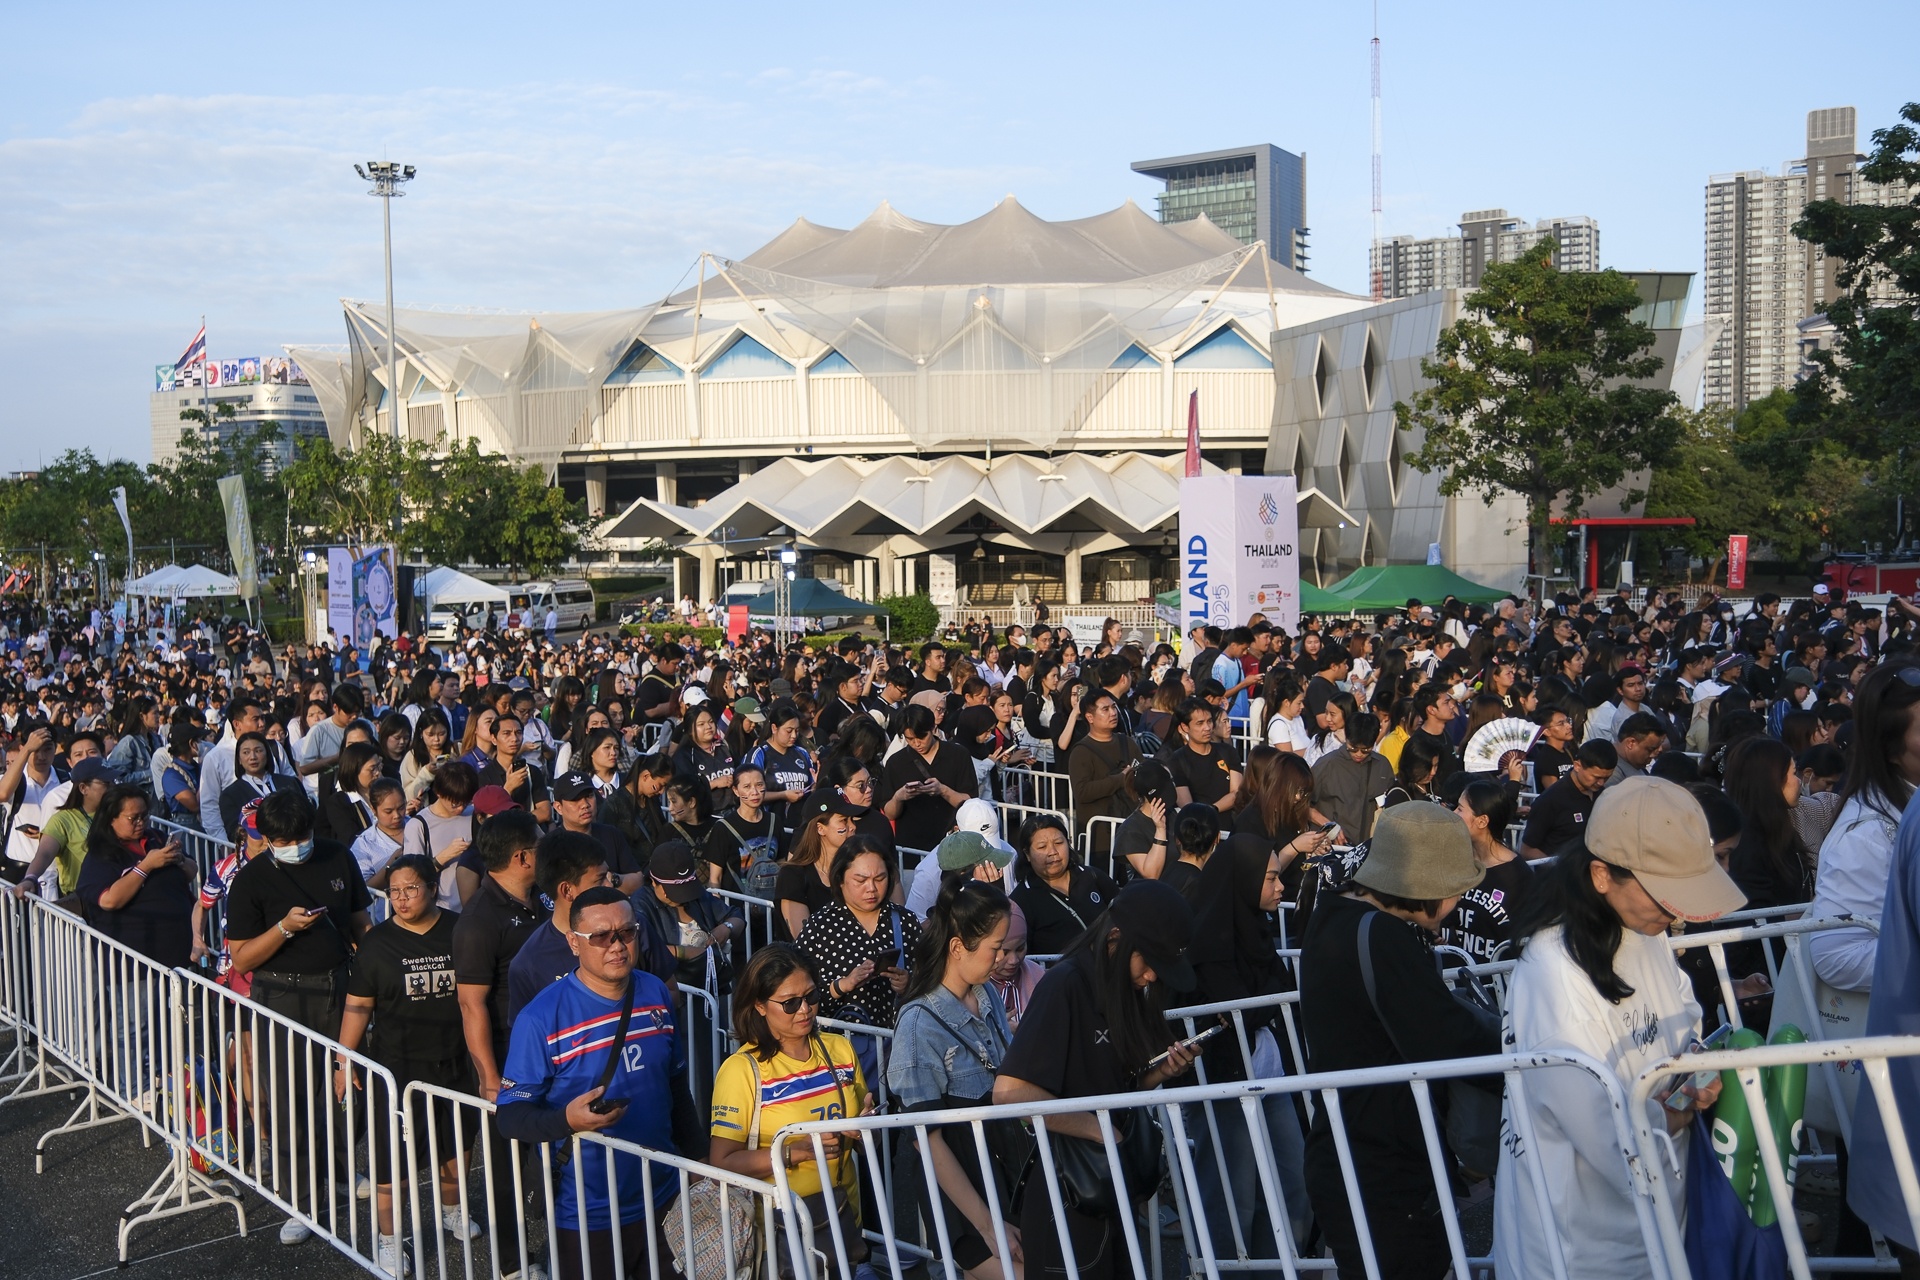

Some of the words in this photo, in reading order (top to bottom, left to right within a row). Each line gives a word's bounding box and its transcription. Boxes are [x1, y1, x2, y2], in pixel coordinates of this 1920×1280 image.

[1244, 543, 1293, 558] THAILAND
[1261, 557, 1279, 569] 2025
[1187, 534, 1209, 629] LAND
[1211, 584, 1230, 631] 025
[1461, 888, 1510, 925] CESSITY
[402, 954, 451, 966] Sweetheart
[411, 962, 445, 971] BlackCat
[1818, 1009, 1850, 1022] THAILAND
[620, 1043, 645, 1073] 12
[810, 1102, 842, 1121] 76
